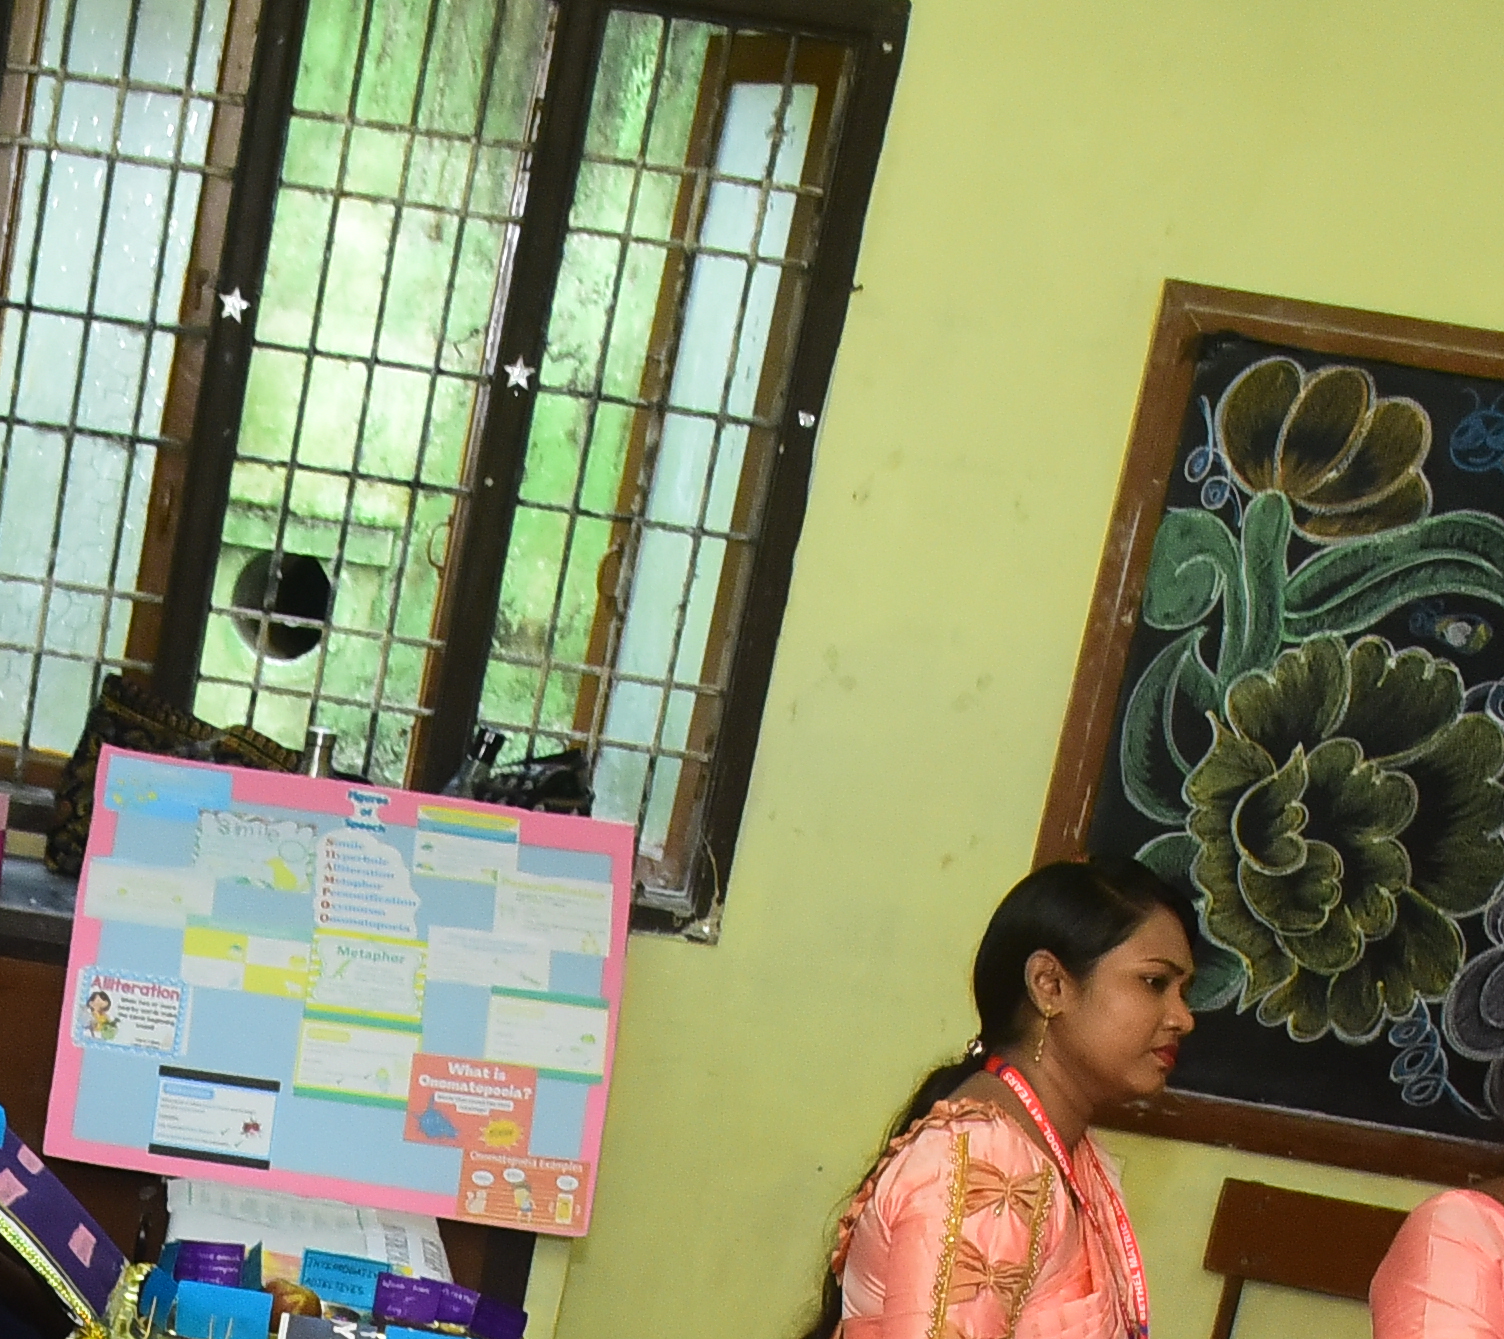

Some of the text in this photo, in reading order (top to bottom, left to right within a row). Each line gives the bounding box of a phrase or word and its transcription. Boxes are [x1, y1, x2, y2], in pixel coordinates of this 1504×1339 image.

[337, 945, 406, 965] Metaphor
[448, 1062, 506, 1082] What is
[1002, 1071, 1035, 1107] YEARS
